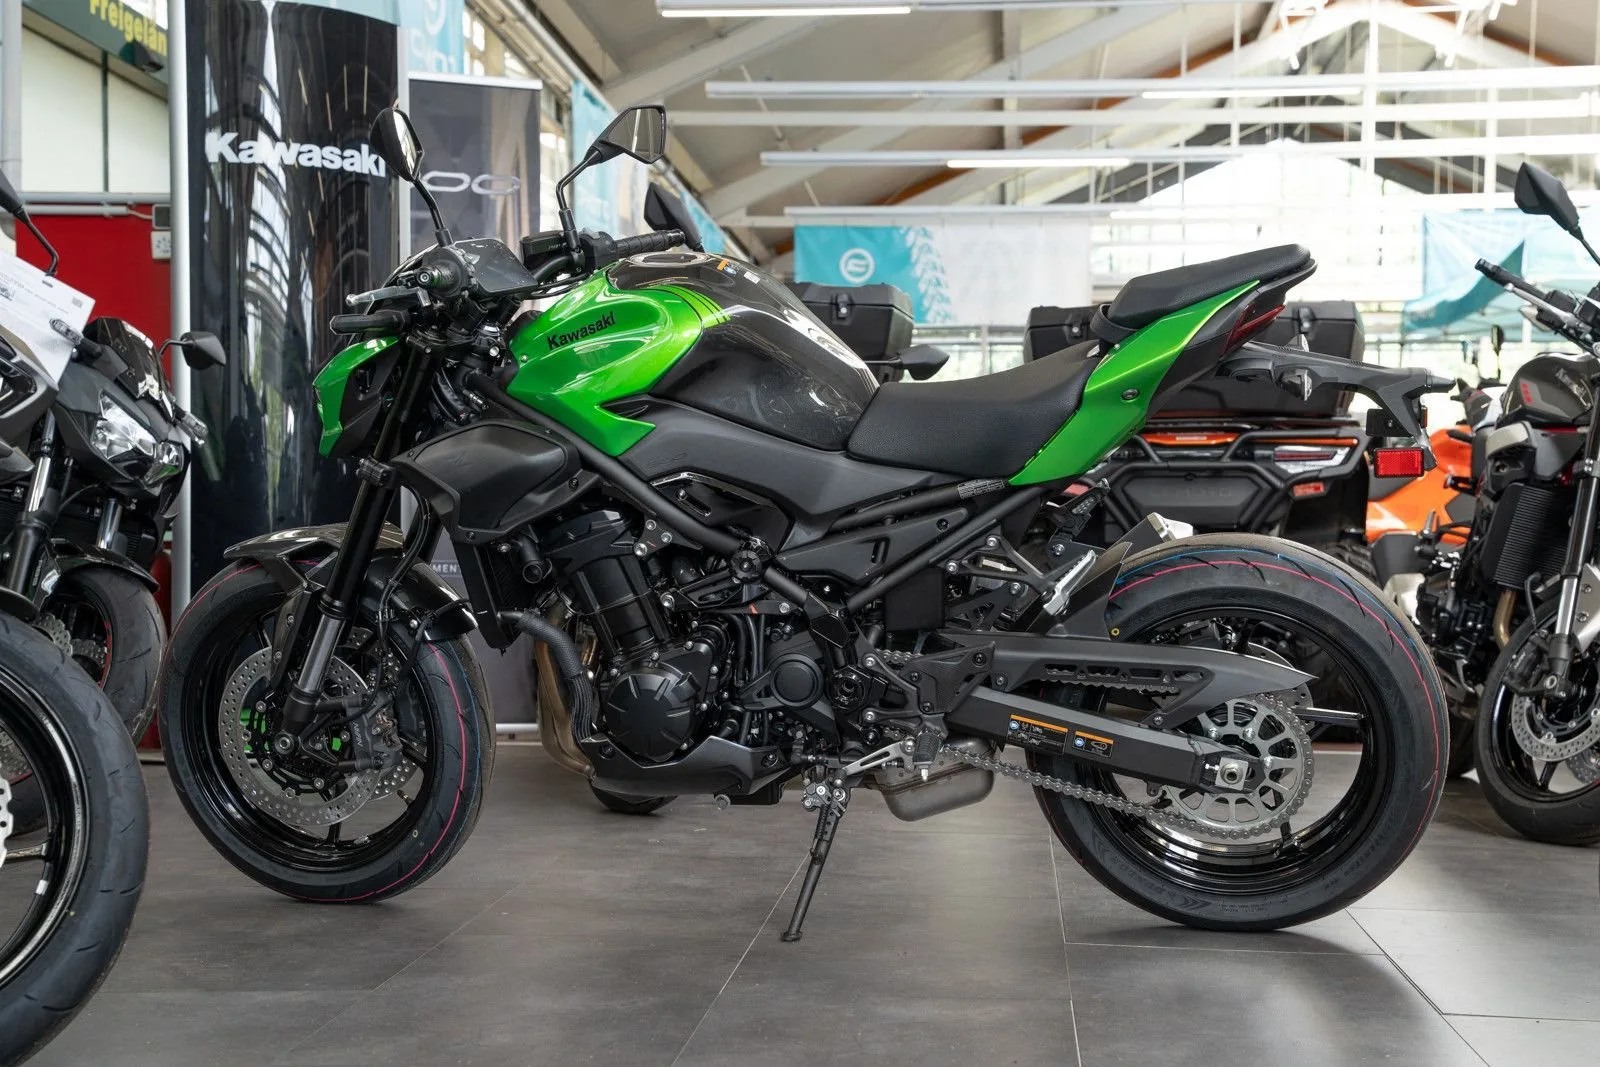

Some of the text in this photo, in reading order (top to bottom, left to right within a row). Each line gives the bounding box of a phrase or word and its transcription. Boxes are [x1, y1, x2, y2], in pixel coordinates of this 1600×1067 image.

[205, 132, 386, 178] Kawasaki
[547, 311, 615, 350] Kawasaki
[432, 563, 460, 573] MEN
